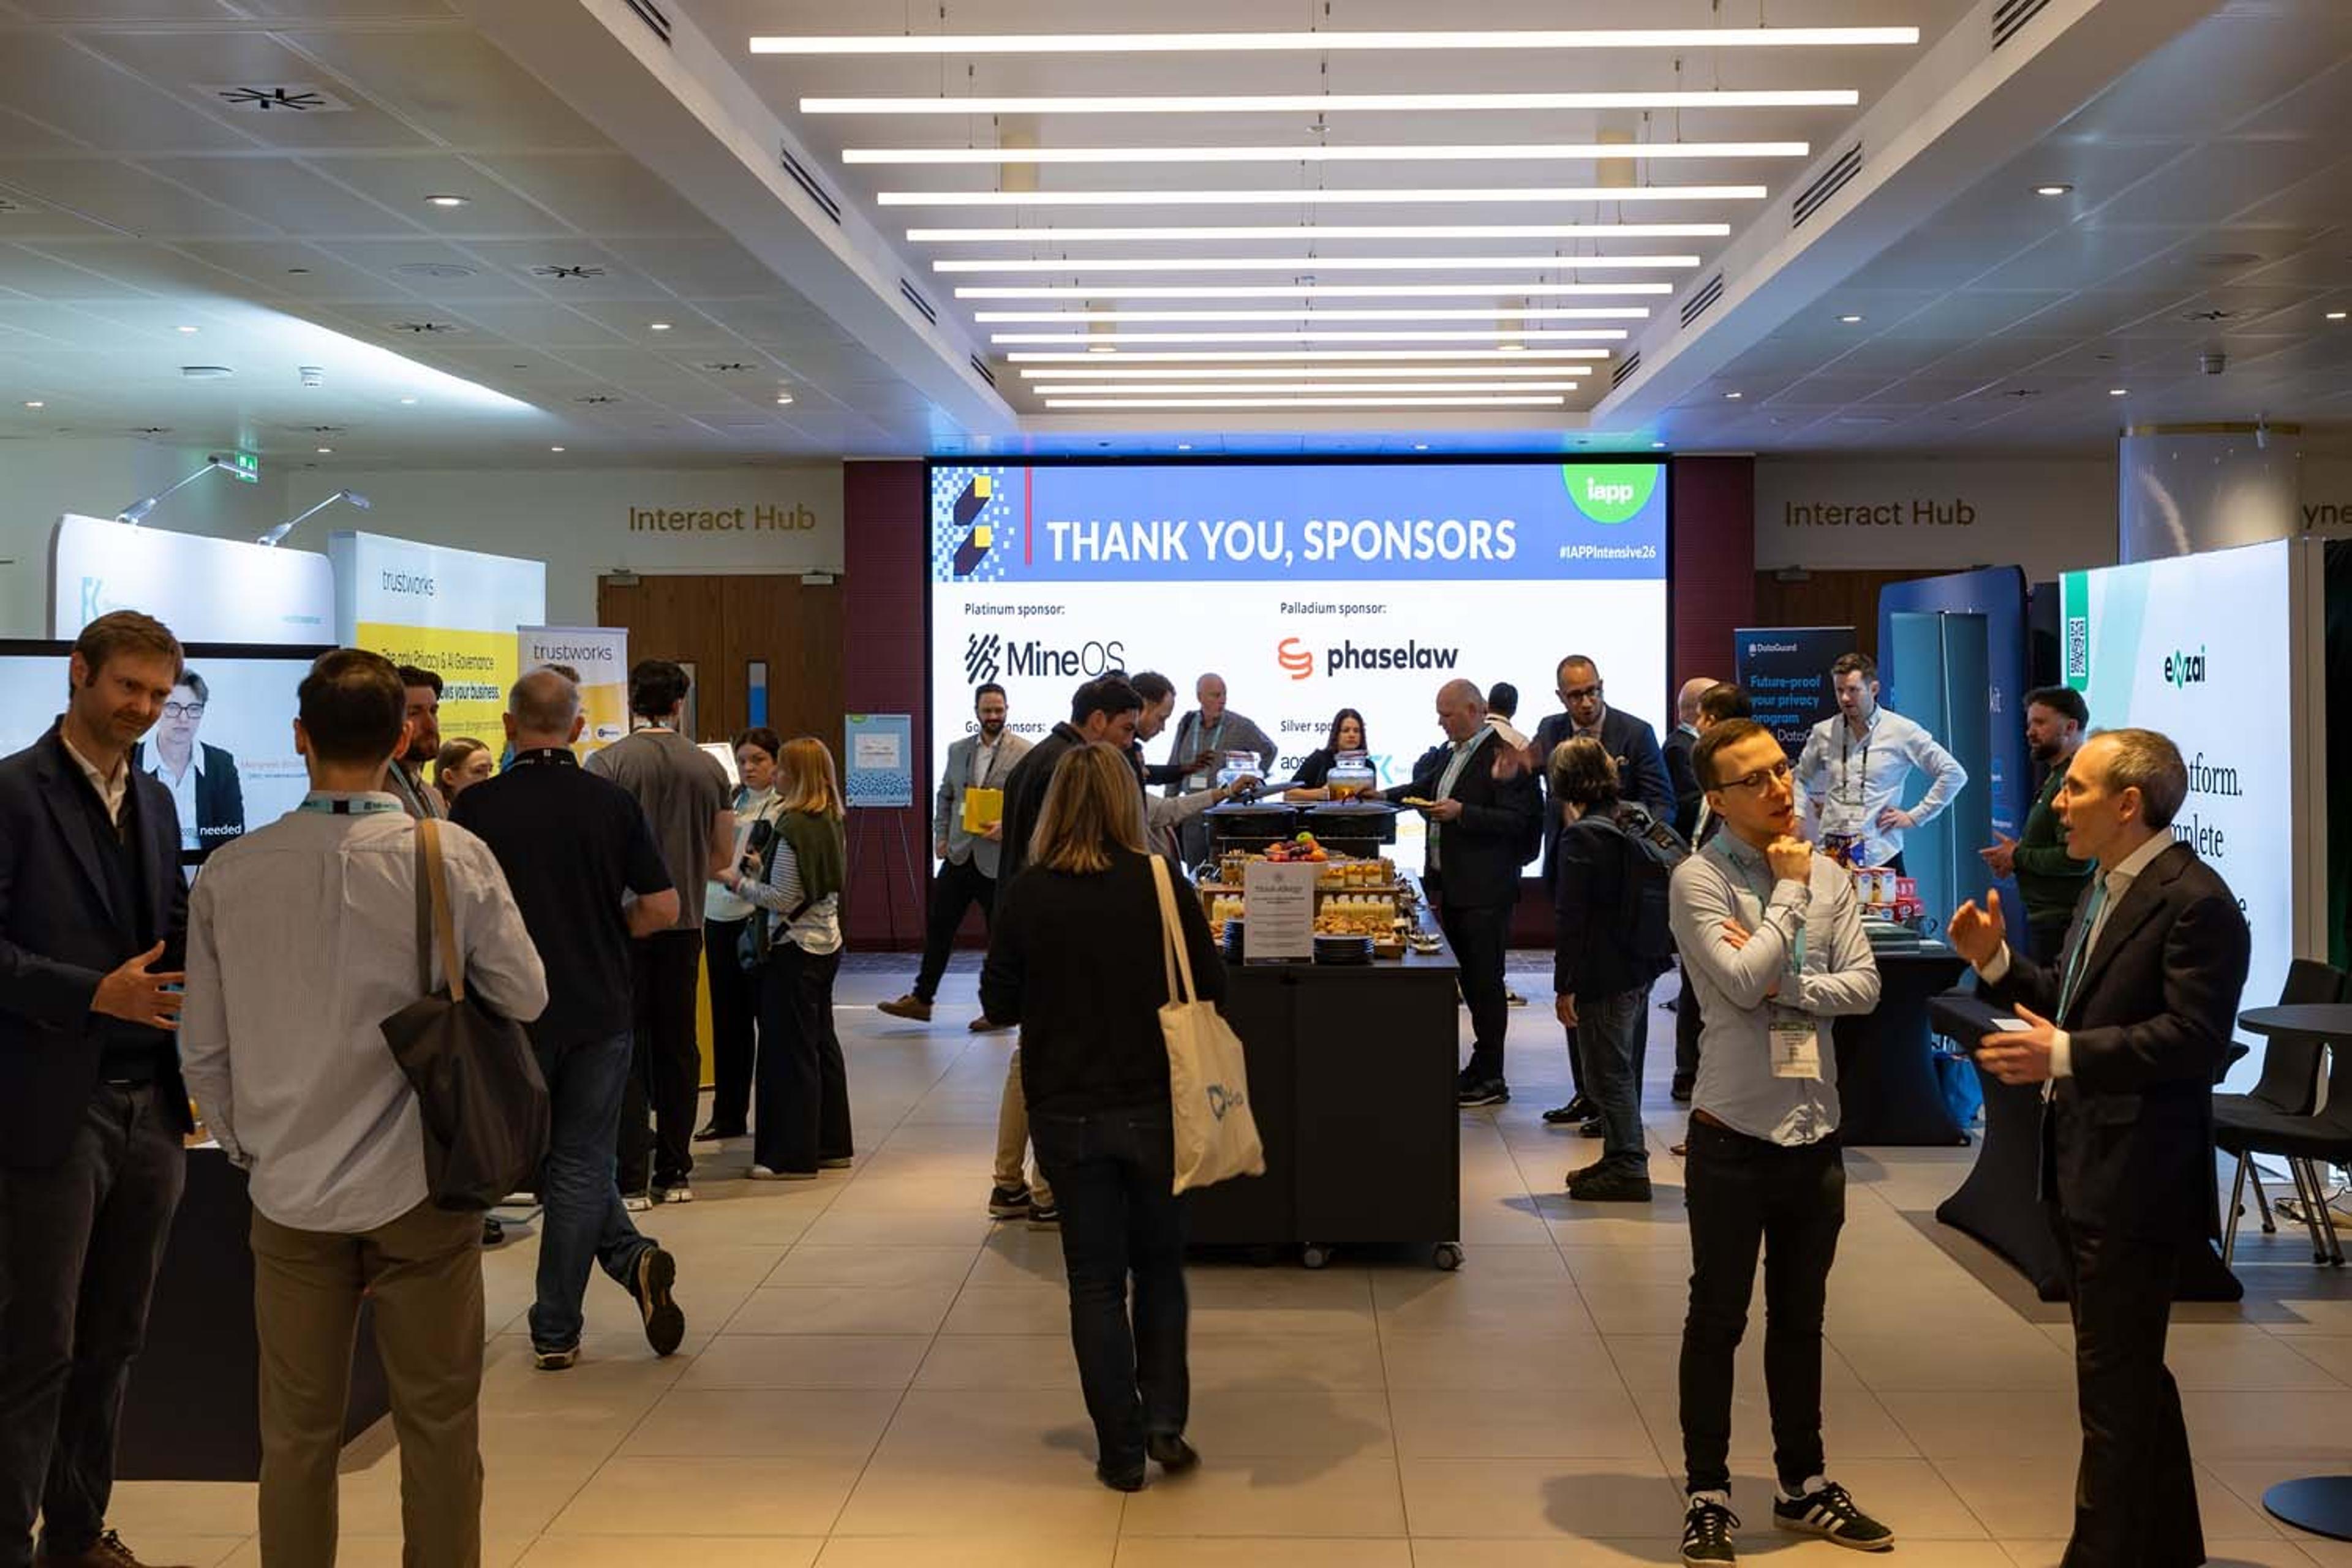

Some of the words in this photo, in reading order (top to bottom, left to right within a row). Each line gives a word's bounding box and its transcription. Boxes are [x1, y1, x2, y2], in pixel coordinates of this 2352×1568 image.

[1587, 477, 1634, 504] iapp
[630, 507, 744, 530] Interact
[755, 503, 815, 530] Hub
[1786, 501, 1902, 526] Interact
[1913, 498, 1975, 526] Hub
[1047, 521, 1189, 562] THANK
[1197, 520, 1294, 567] YOU,
[1304, 520, 1517, 562] SPONSORS
[1560, 545, 1656, 559] #IAPPIntensive26
[382, 570, 434, 596] trustworks
[965, 602, 1015, 615] Platinum
[1017, 603, 1065, 619] sponsor:
[1281, 602, 1336, 614] Palladium
[1339, 603, 1387, 617] sponsor:
[415, 650, 439, 670] Privacy
[455, 652, 494, 670] Governance
[533, 644, 612, 661] trustworks
[1008, 641, 1125, 676] MineOS
[1328, 639, 1458, 677] phaselaw
[1751, 676, 1820, 688] Future-proof
[455, 686, 470, 704] your
[1751, 696, 1774, 708] your
[1778, 694, 1819, 709] privacy
[965, 721, 980, 733] Go
[1006, 722, 1046, 733] onsors:
[1281, 720, 1310, 732] Silver
[1752, 714, 1799, 726] program
[2189, 752, 2242, 796] tform.
[200, 824, 241, 835] needed
[2171, 813, 2223, 858] mplete
